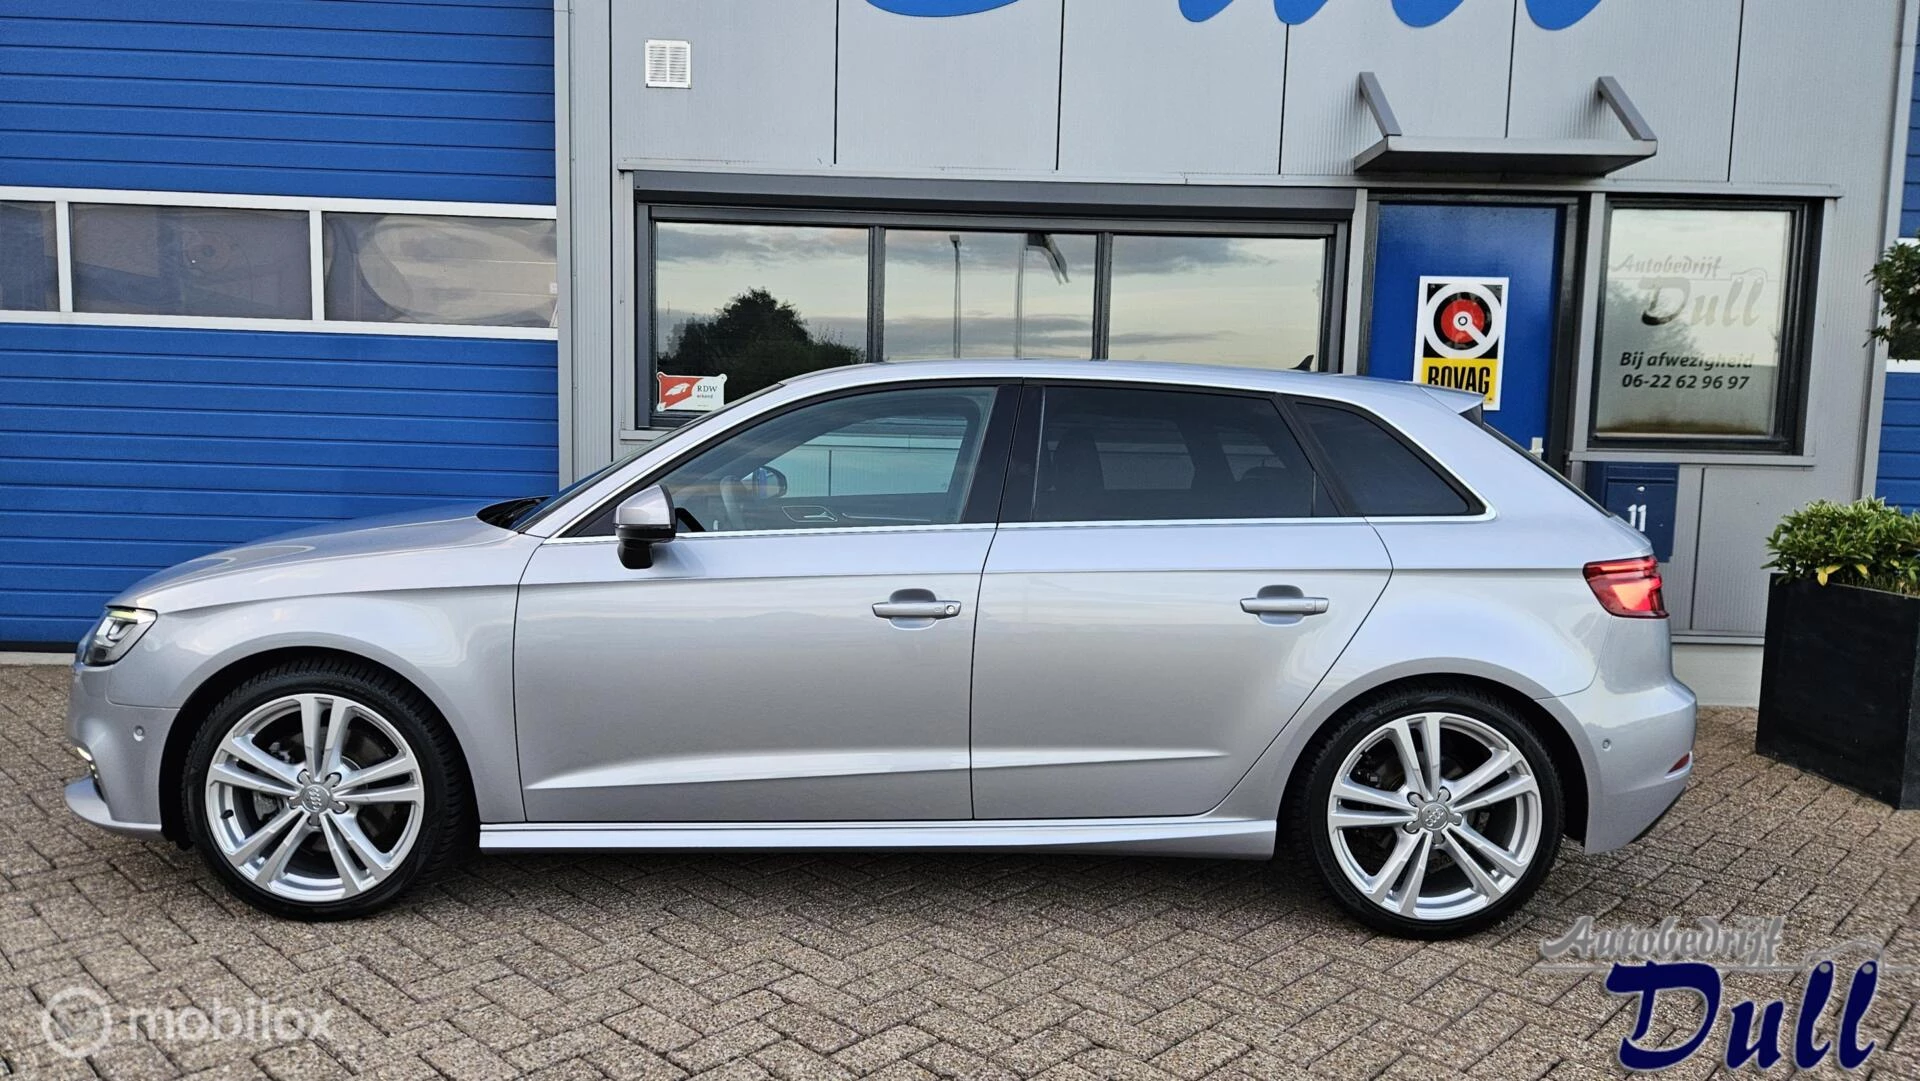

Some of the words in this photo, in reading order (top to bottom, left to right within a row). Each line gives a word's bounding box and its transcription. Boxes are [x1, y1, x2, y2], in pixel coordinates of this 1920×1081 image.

[1608, 254, 1722, 278] Autobedrijf
[1638, 277, 1764, 327] Dull
[1620, 352, 1645, 370] Bij
[1647, 352, 1754, 371] afwezigheid
[1427, 365, 1491, 395] BOVAG
[1622, 374, 1672, 388] 06-22
[1676, 375, 1697, 389] 62
[1702, 376, 1723, 389] 96
[1727, 376, 1750, 390] 97
[1627, 504, 1647, 532] 11
